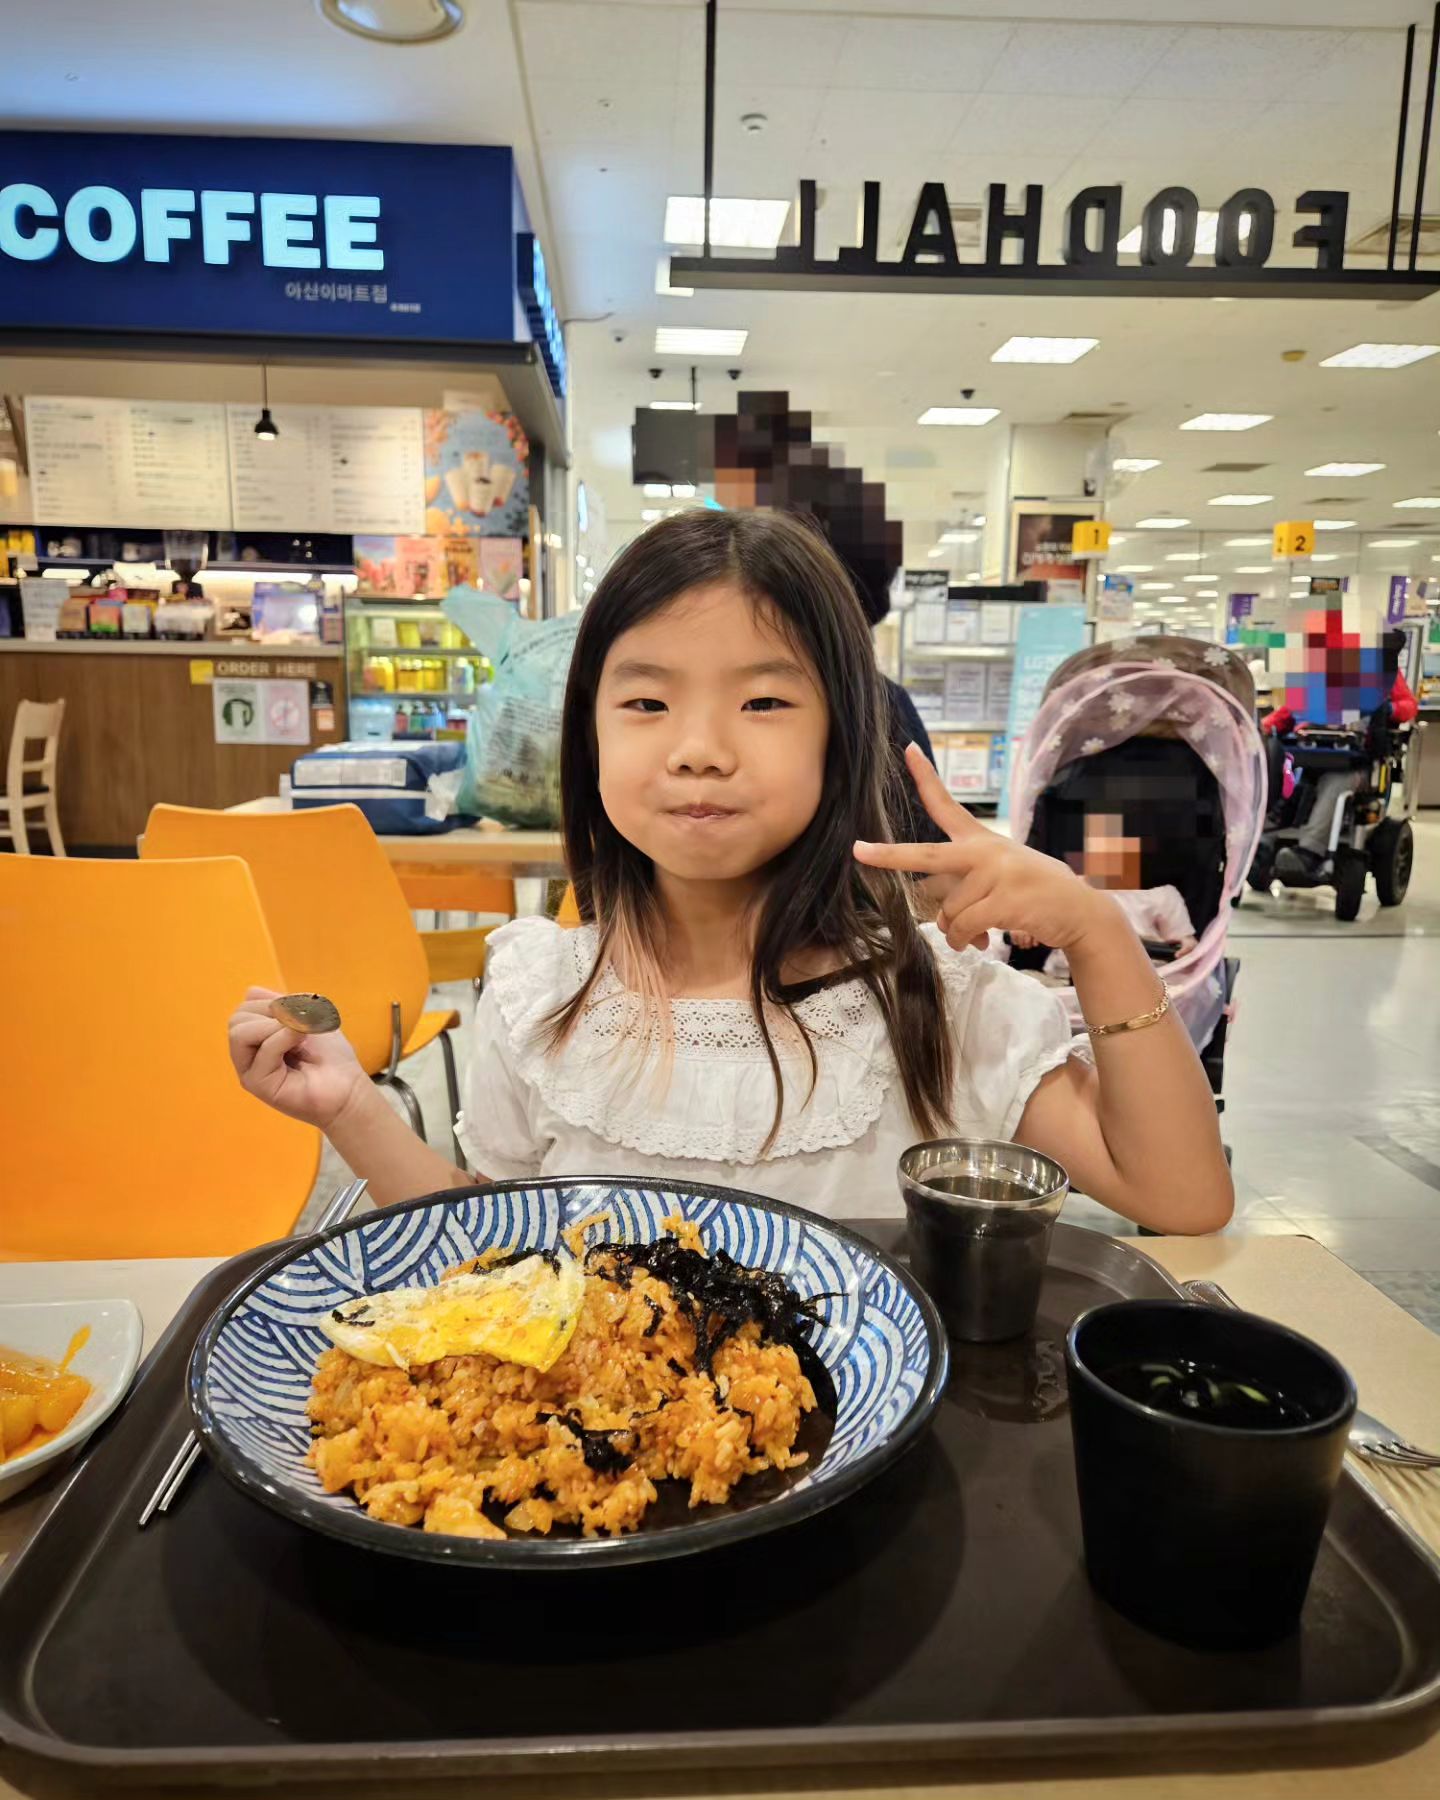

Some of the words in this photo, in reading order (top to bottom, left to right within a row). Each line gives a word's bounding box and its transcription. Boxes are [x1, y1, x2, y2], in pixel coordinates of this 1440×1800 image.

[0, 183, 384, 270] COFFEE
[285, 282, 388, 304] 아산이마트점
[1295, 535, 1306, 552] 2
[217, 661, 270, 676] ORDER
[275, 663, 317, 677] HERE
